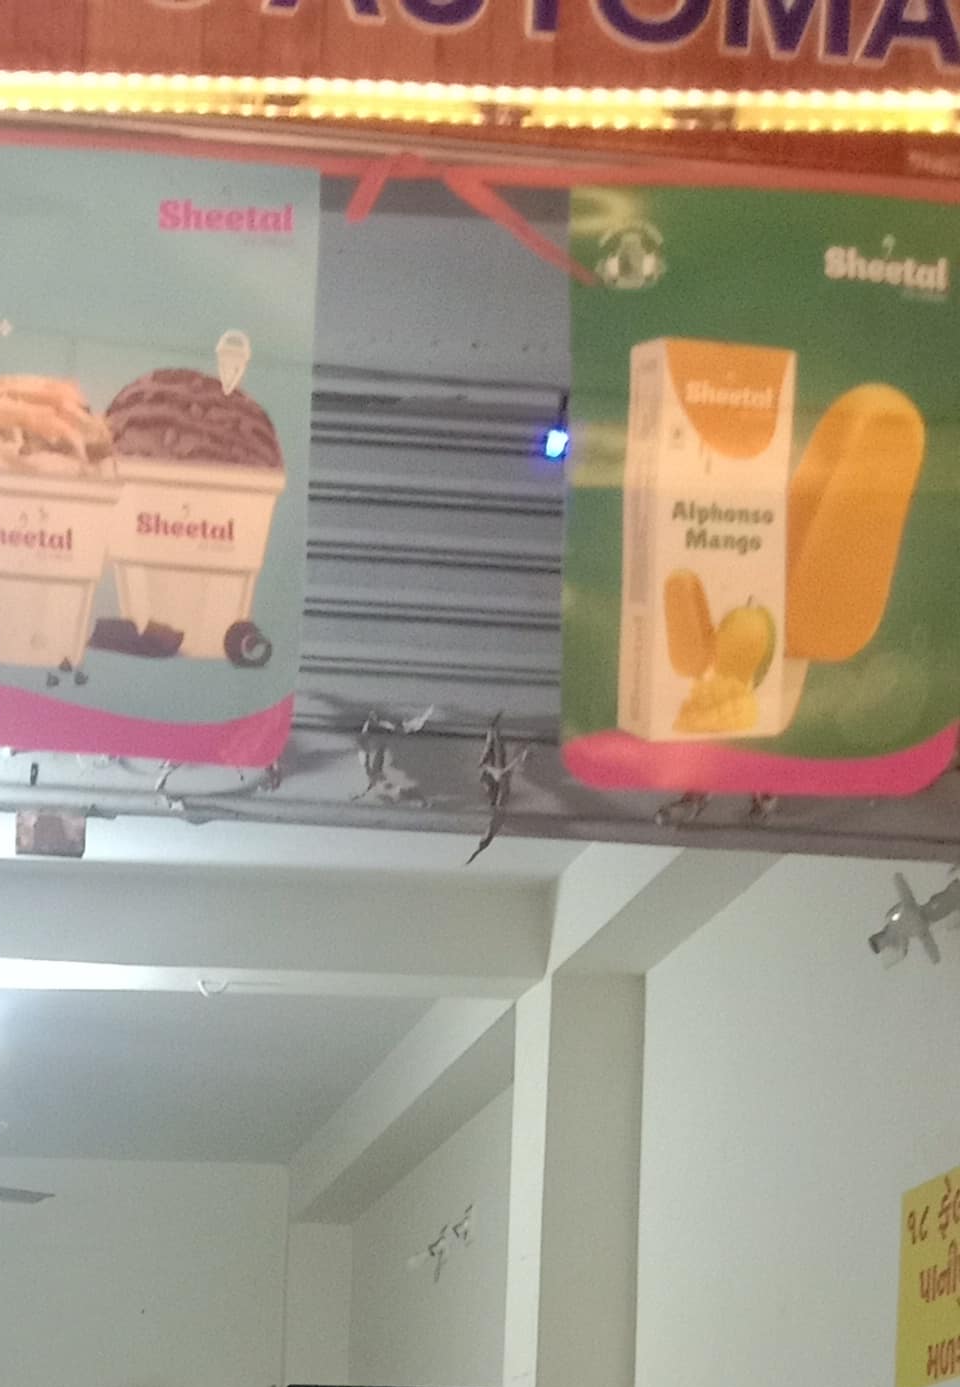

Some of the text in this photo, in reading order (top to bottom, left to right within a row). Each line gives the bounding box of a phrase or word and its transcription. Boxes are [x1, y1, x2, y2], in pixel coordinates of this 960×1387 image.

[158, 200, 295, 235] Sheetal
[824, 245, 949, 293] Sheetal
[685, 379, 776, 408] Sheetal
[671, 500, 775, 526] Alphonso
[136, 513, 236, 543] Sheetal
[685, 528, 762, 555] Mango
